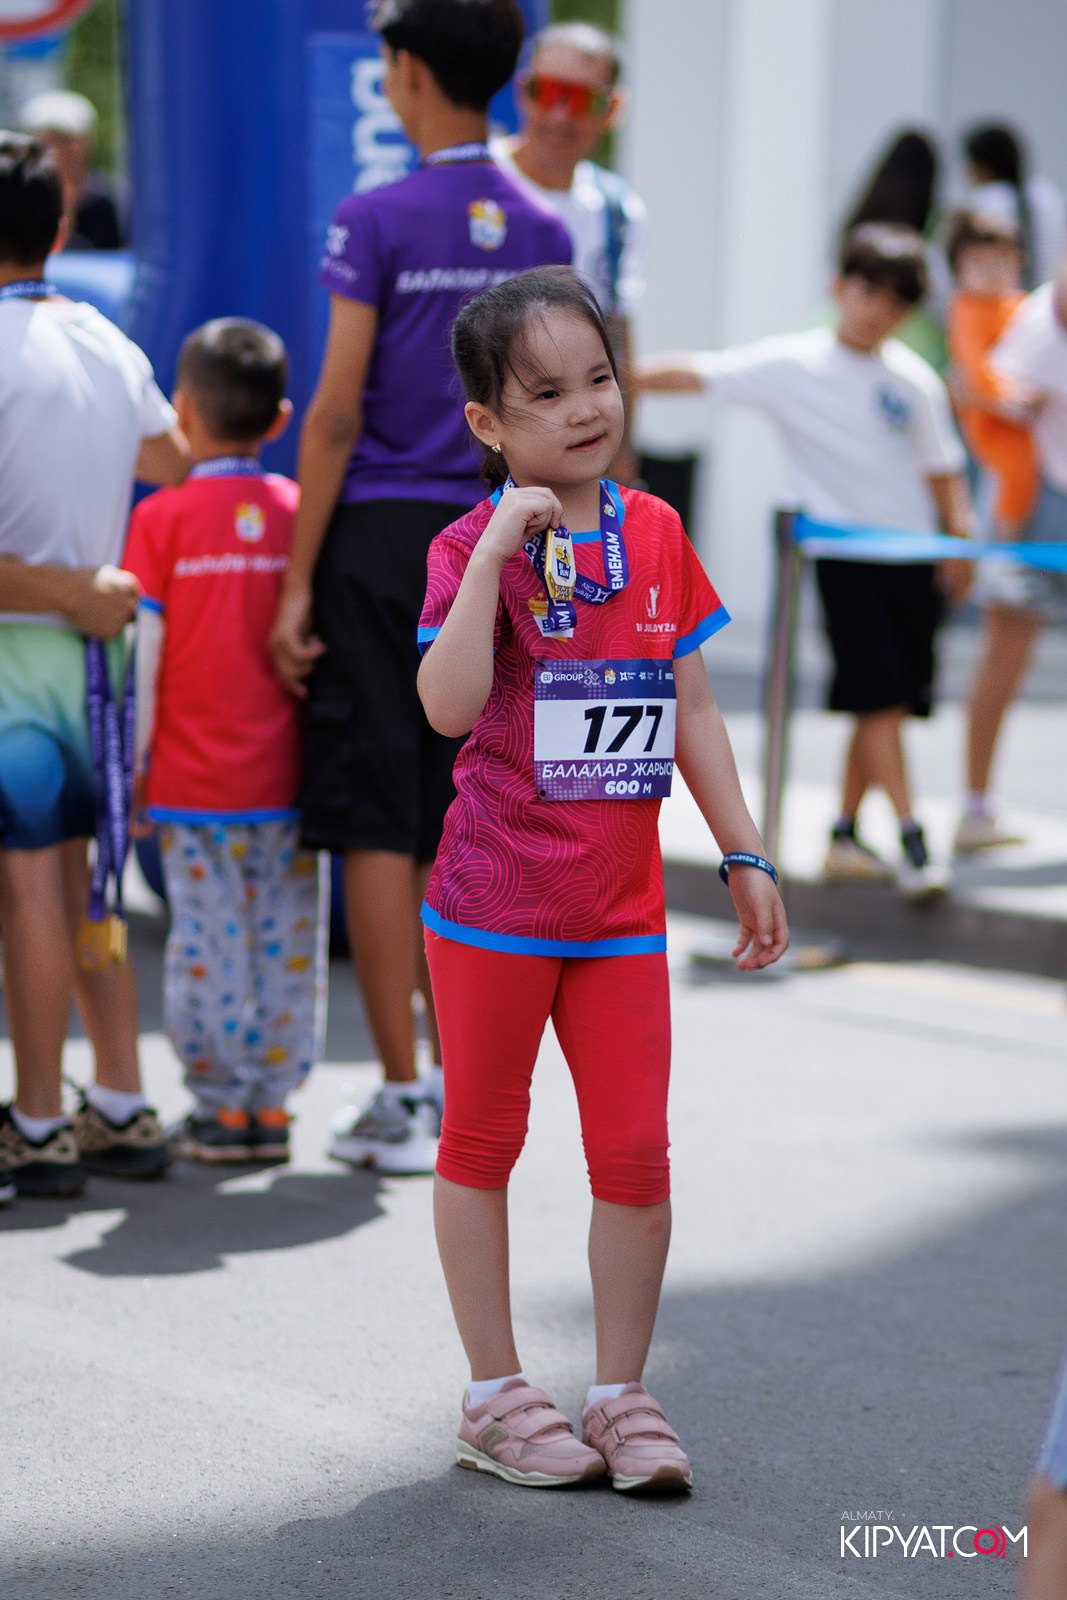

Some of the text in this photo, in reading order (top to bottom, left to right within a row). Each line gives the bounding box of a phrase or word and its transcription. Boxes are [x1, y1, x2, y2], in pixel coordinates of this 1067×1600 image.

[554, 673, 584, 681] GROUP
[583, 705, 663, 754] 177
[542, 763, 628, 778] БАЛАЛАР
[604, 780, 640, 795] 600
